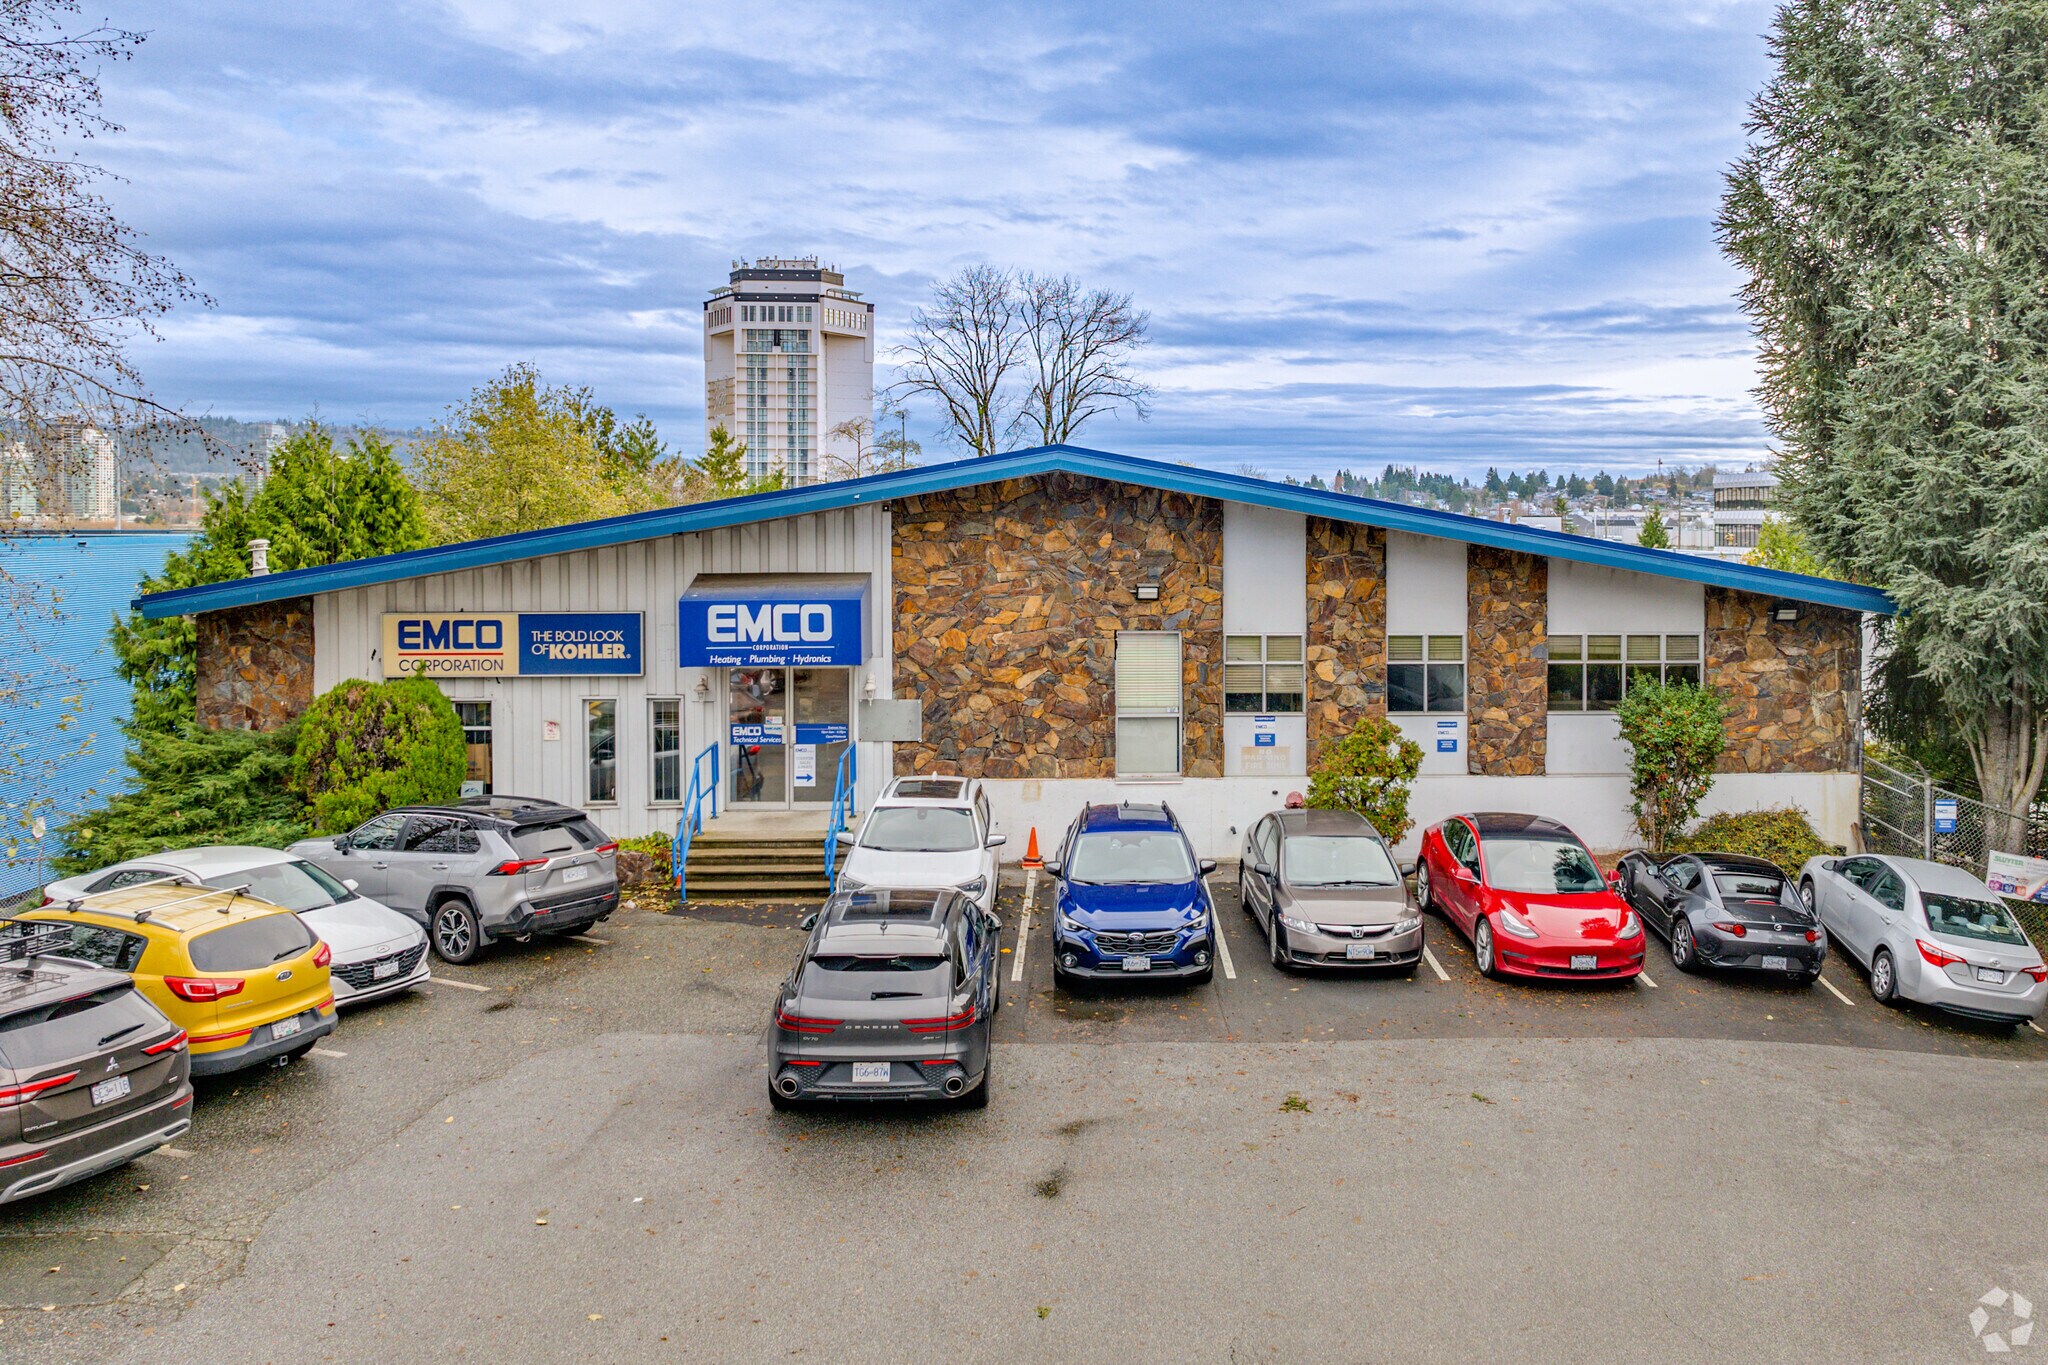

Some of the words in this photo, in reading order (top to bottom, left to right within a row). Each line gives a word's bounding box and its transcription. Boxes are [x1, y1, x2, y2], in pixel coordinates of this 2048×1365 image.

[707, 604, 833, 643] EMCO
[397, 619, 503, 650] EMCO
[531, 630, 553, 642] THE
[555, 630, 588, 642] BOLD
[589, 630, 624, 642] LOOK
[531, 643, 549, 656] OF
[398, 659, 504, 672] CORPORATION
[709, 654, 742, 665] Heating
[749, 654, 786, 665] Plumbing
[792, 654, 832, 664] Hydronics
[732, 726, 762, 736] EMCO
